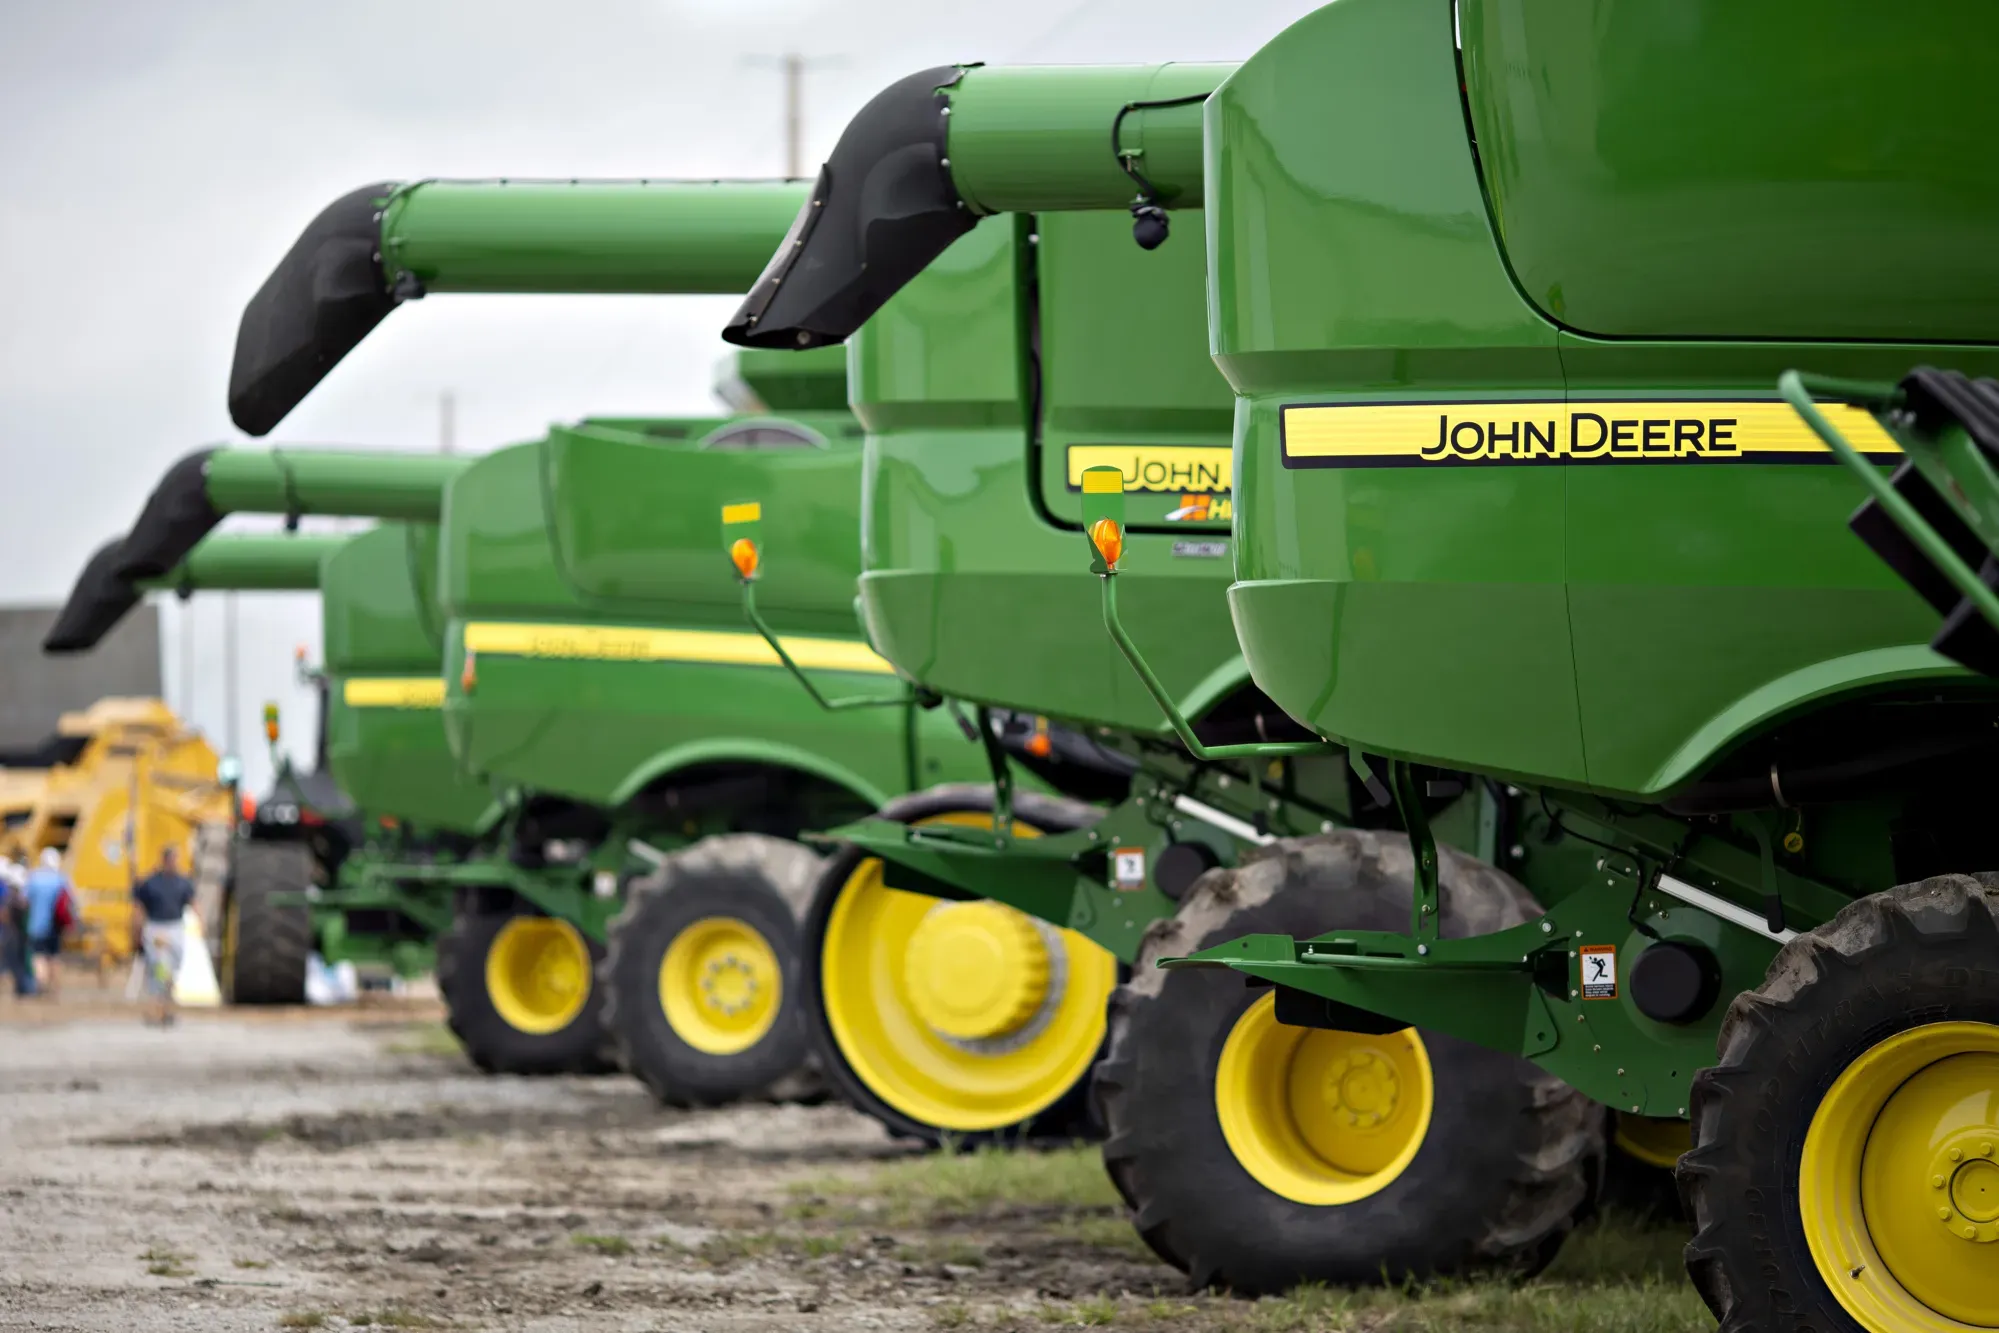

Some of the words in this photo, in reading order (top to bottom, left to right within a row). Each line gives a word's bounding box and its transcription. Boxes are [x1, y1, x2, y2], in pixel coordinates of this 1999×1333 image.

[1421, 414, 1556, 455] JOHN
[1570, 412, 1737, 453] DEERE
[1123, 456, 1220, 485] JOHN
